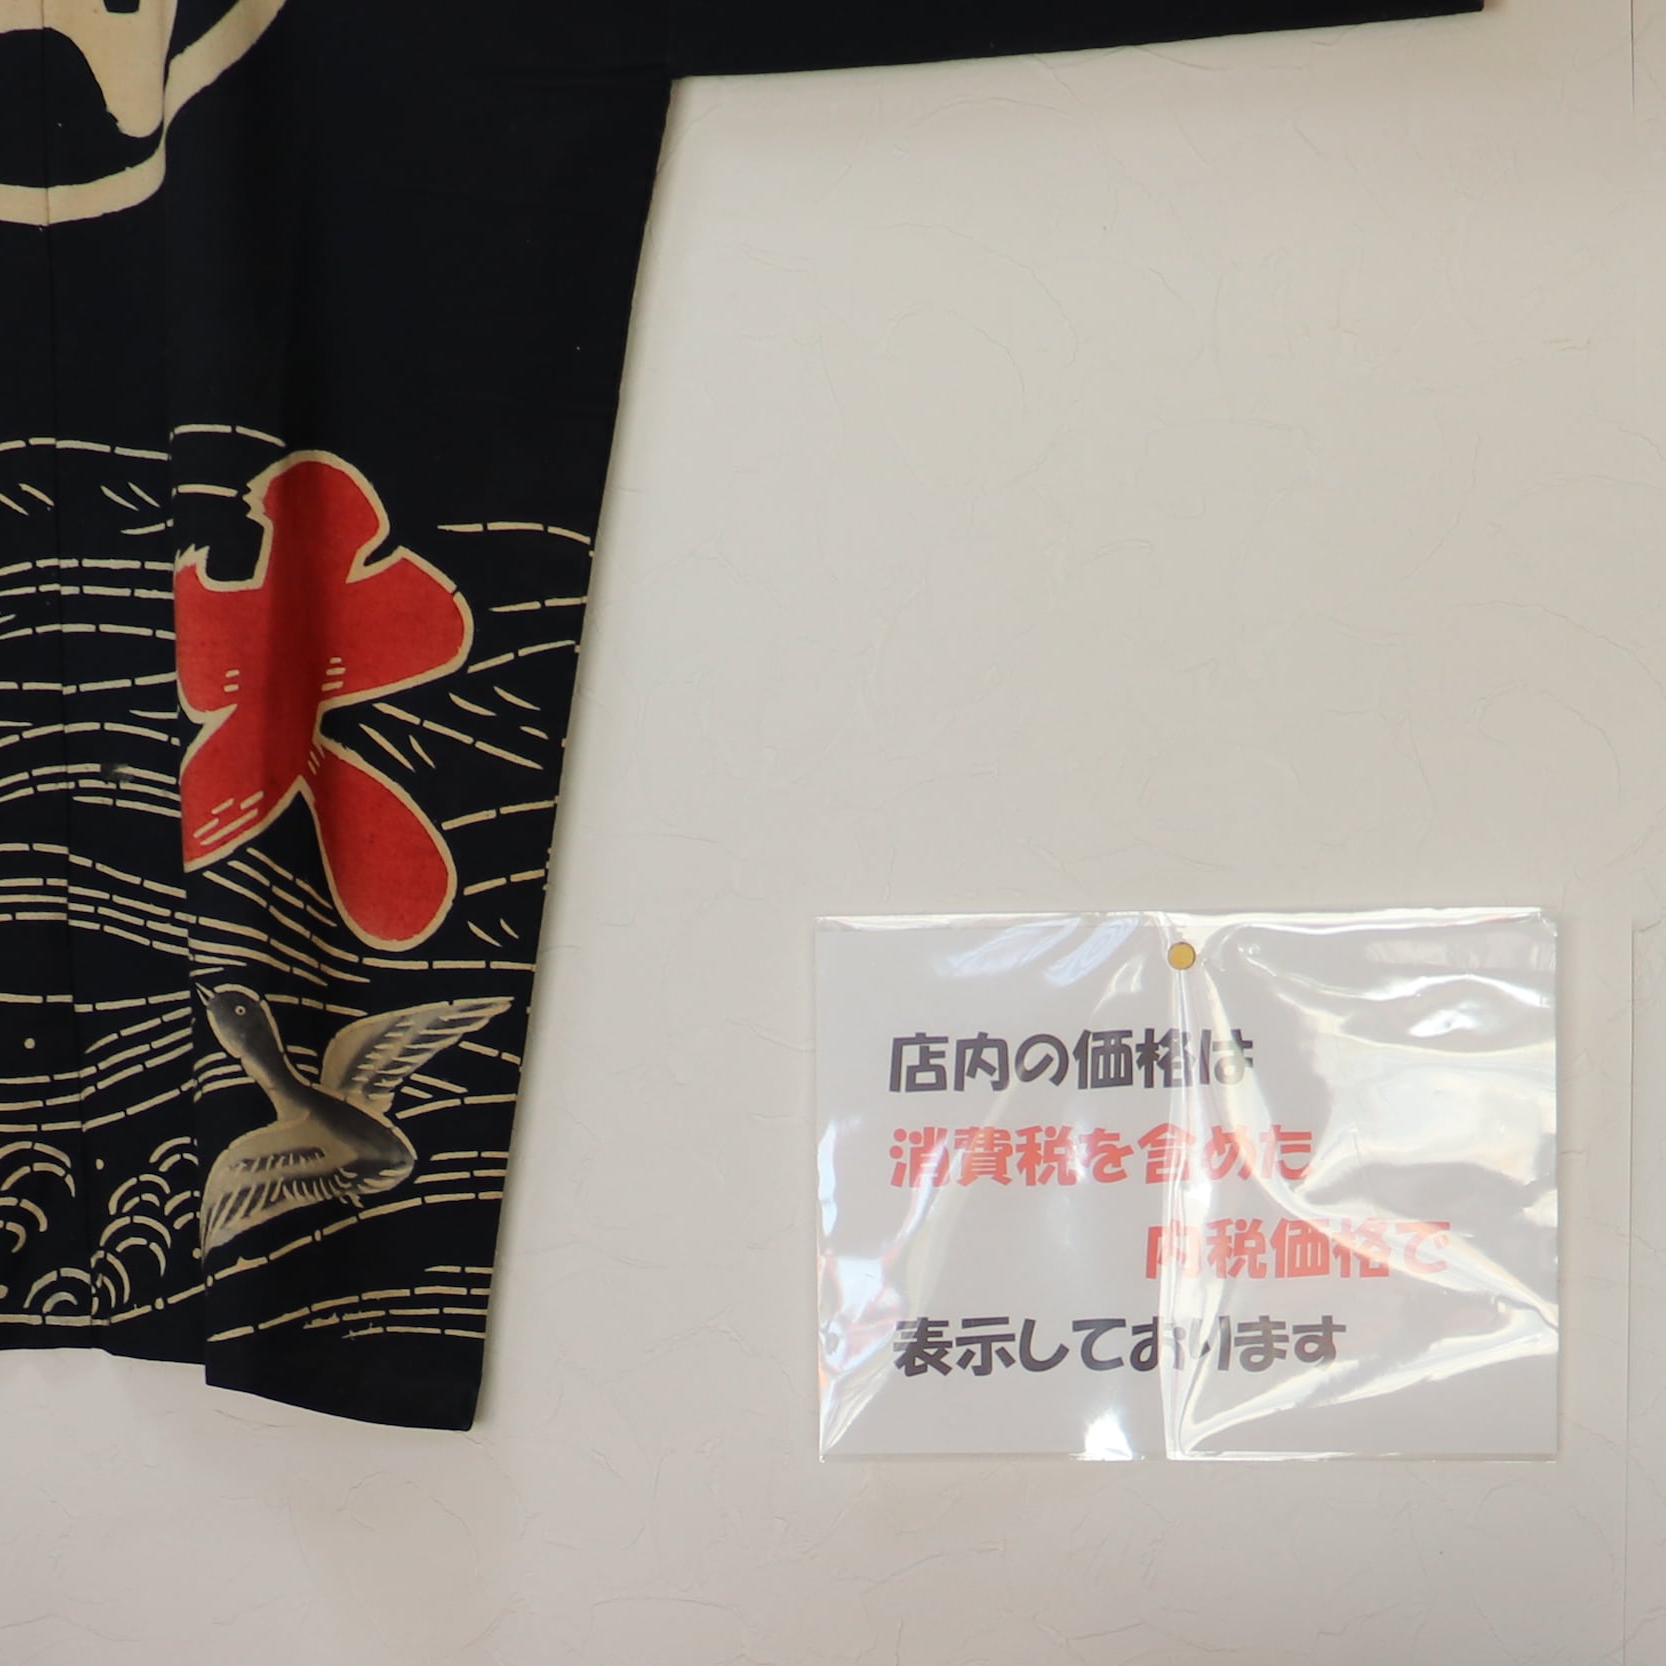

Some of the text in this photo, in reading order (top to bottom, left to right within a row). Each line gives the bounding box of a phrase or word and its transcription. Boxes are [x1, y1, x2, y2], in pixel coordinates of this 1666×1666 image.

[887, 1028, 1254, 1093] 店内の価格は
[888, 1122, 1315, 1187] 消費税を含めた
[1145, 1217, 1451, 1280] 内税価格で
[893, 1315, 1346, 1377] 表示しております
